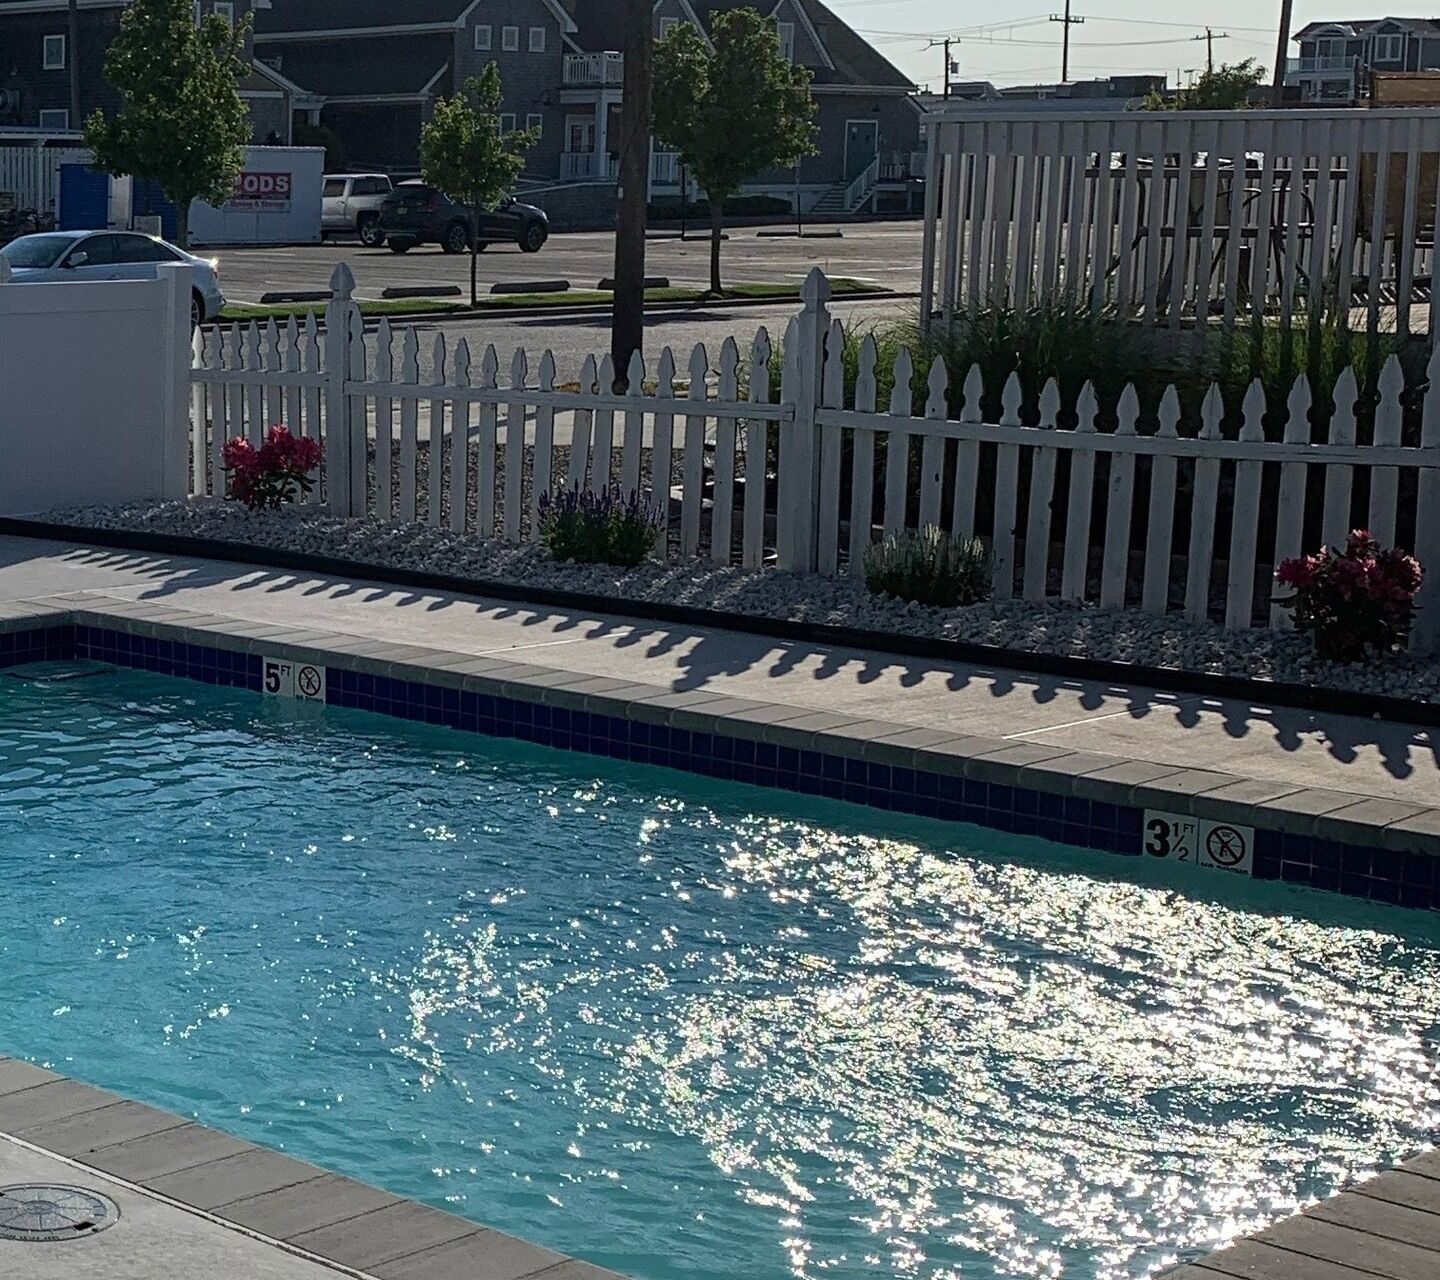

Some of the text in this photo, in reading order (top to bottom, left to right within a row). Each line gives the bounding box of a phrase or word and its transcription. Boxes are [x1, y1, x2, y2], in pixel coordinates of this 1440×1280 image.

[265, 662, 291, 693] 5 FT
[1145, 818, 1171, 858] 3
[1183, 823, 1195, 834] FT
